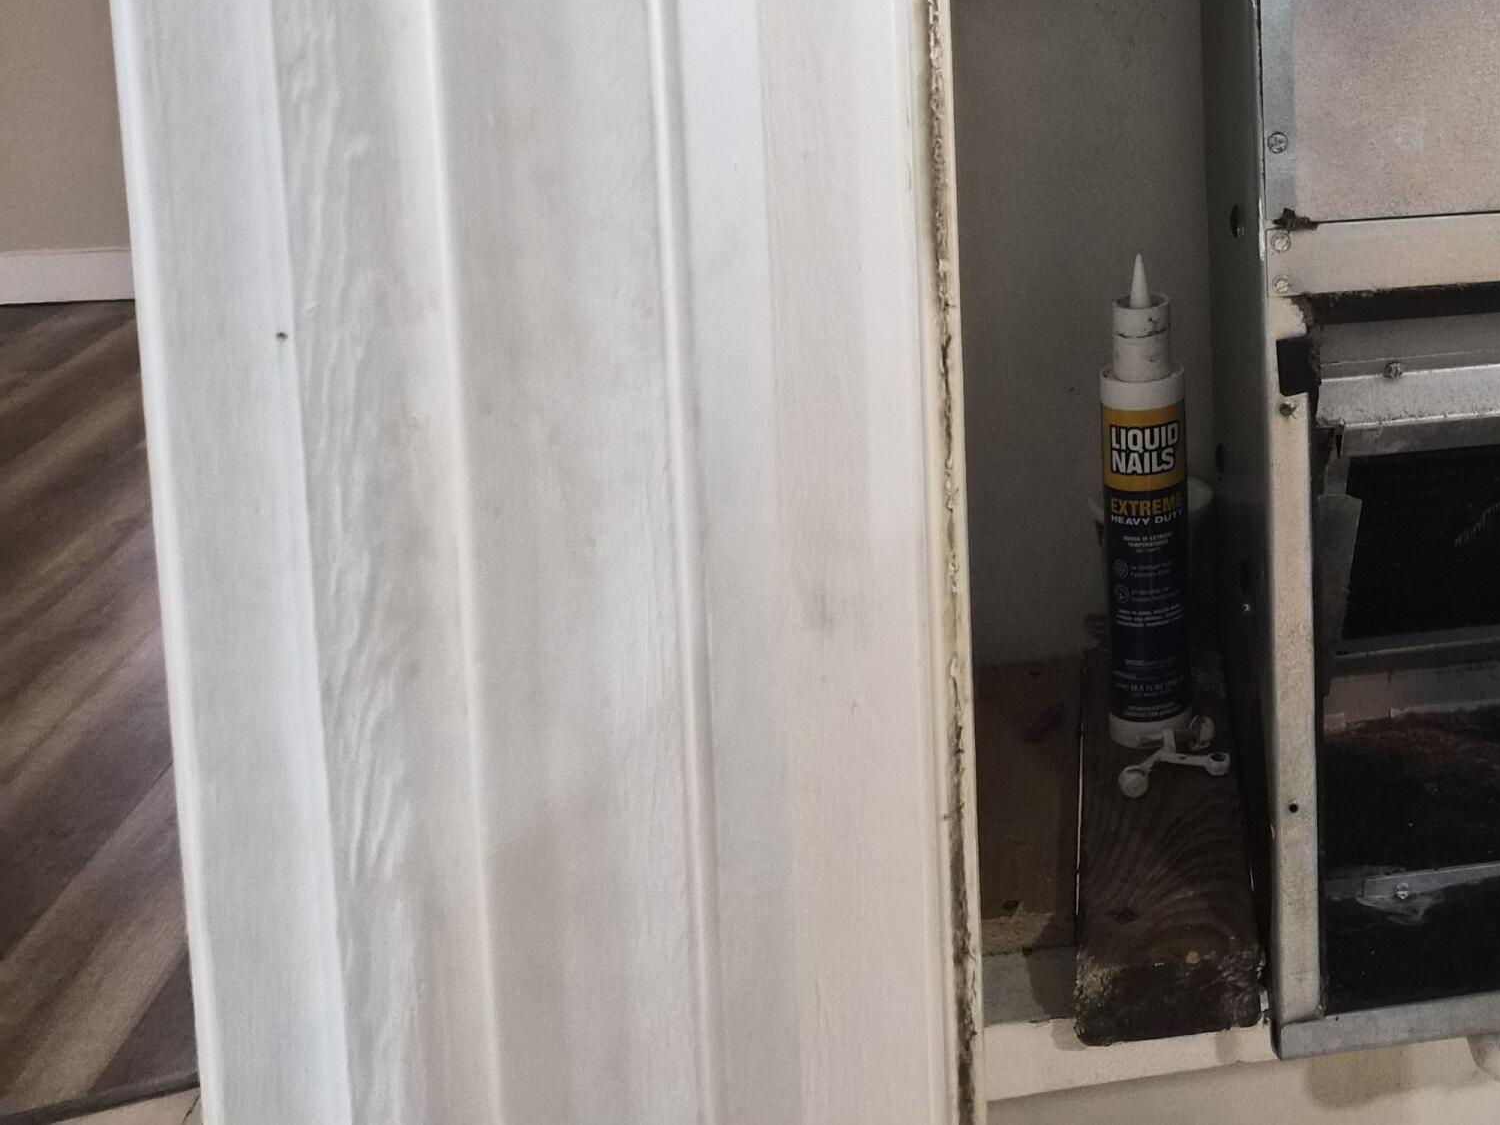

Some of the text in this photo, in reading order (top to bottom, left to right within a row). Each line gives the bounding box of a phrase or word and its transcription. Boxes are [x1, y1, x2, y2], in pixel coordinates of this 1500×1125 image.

[1111, 422, 1178, 453] LIQUID
[1112, 447, 1174, 474] NAILS
[1111, 493, 1184, 516] EXTREME
[1111, 509, 1183, 525] HEAVY DUTY
